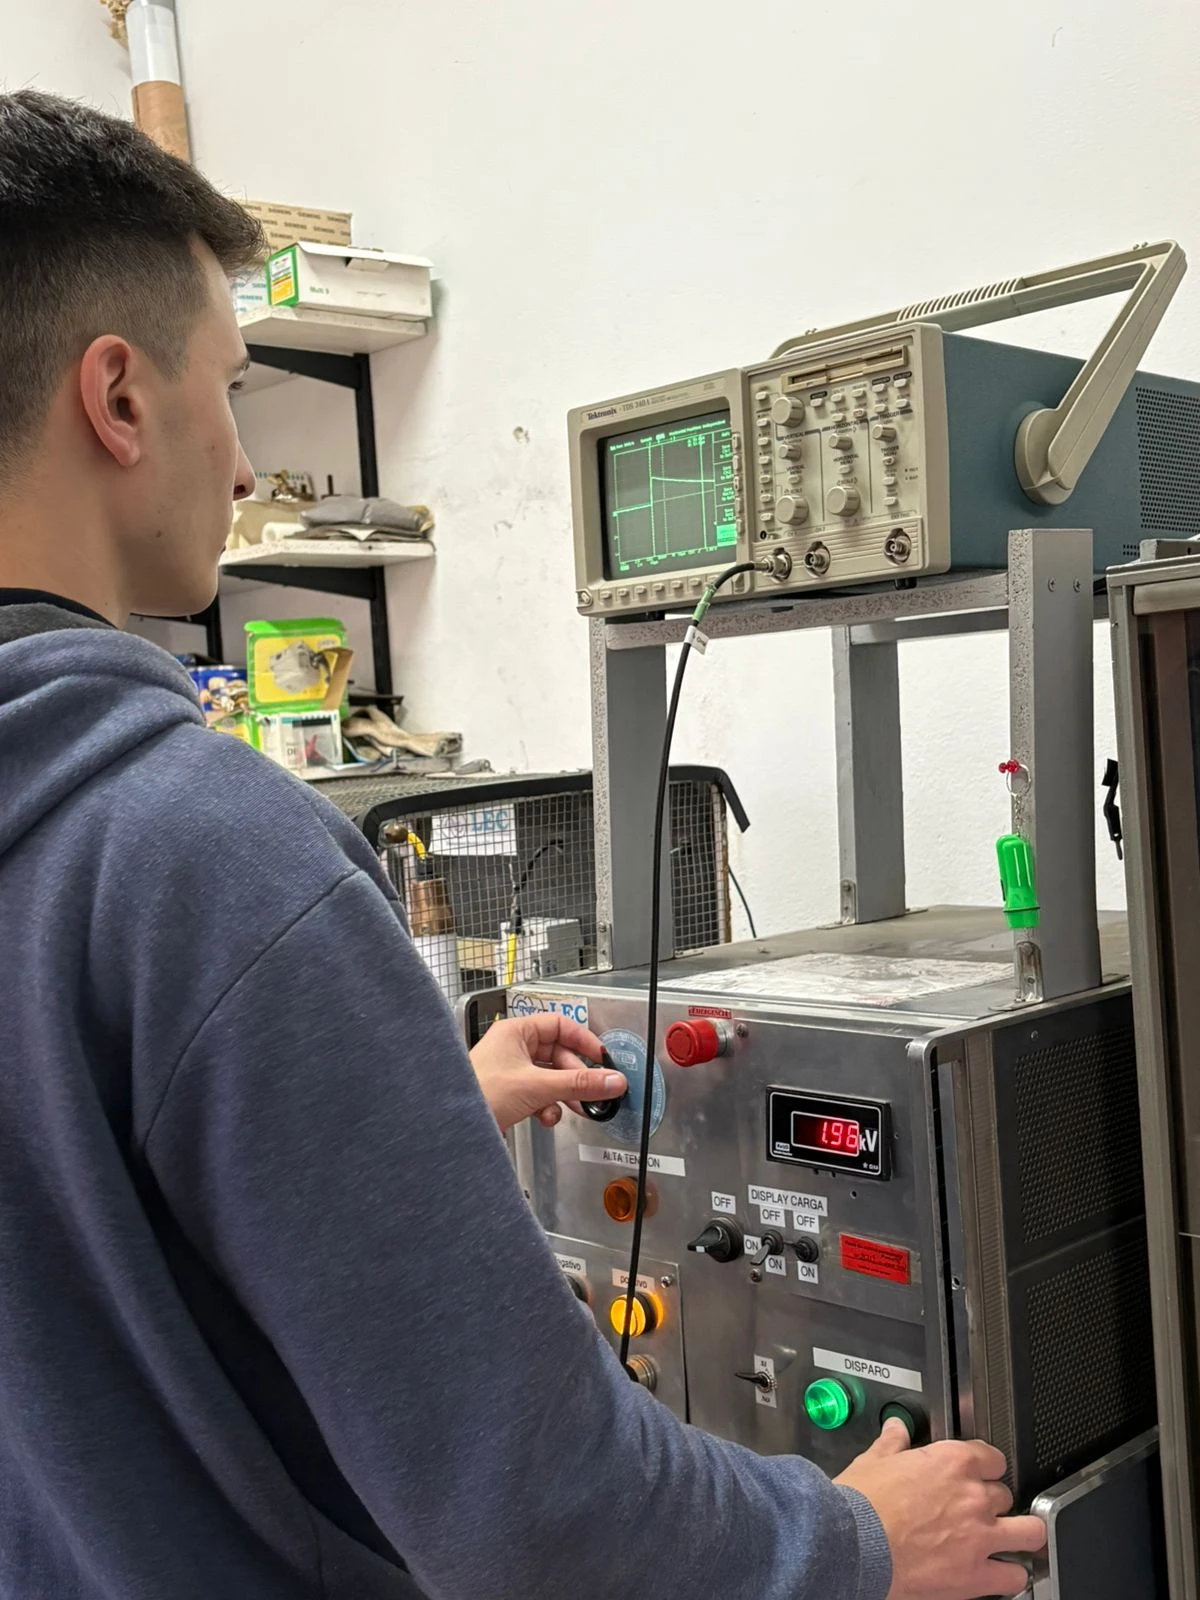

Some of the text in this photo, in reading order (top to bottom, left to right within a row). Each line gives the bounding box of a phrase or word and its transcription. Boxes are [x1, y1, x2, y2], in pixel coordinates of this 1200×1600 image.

[587, 407, 617, 420] Tektronix
[470, 809, 509, 833] LEC
[859, 1129, 878, 1152] kV
[603, 1150, 660, 1168] ALTA TENON
[713, 1195, 731, 1208] OFF
[751, 1189, 824, 1211] DISPLAY CARGA
[762, 1209, 781, 1221] OFF
[796, 1214, 816, 1228] OFF
[745, 1238, 759, 1250] ON
[768, 1257, 783, 1270] ON
[800, 1265, 815, 1278] ON
[620, 1275, 648, 1289] poivo
[844, 1358, 890, 1379] DISPARO
